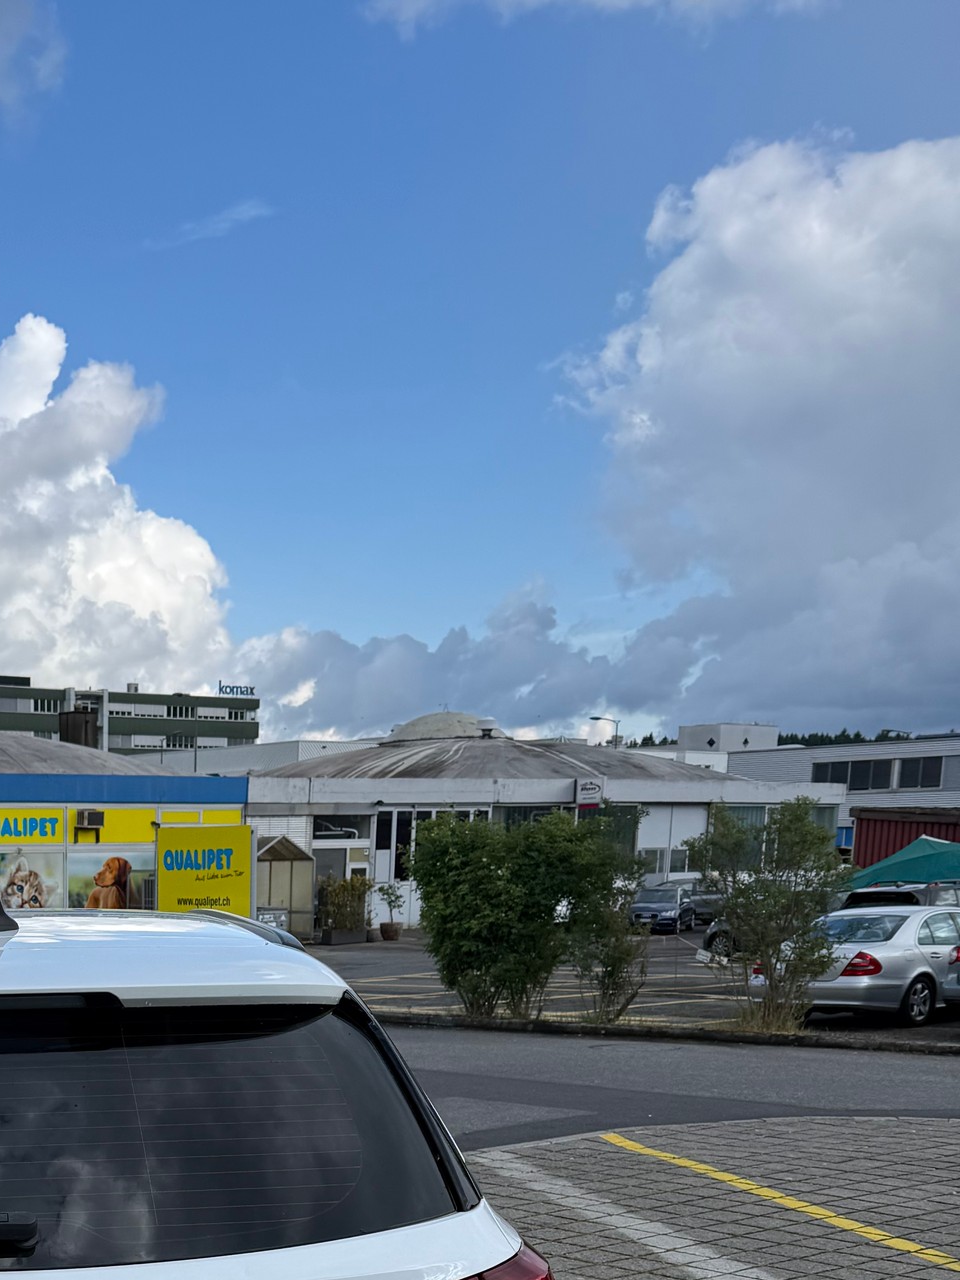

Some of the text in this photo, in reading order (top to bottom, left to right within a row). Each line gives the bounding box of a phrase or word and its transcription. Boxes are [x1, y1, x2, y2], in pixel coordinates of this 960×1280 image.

[219, 680, 255, 696] komax
[163, 848, 233, 871] QUALIPET
[177, 896, 231, 909] www.qualipet.ch
